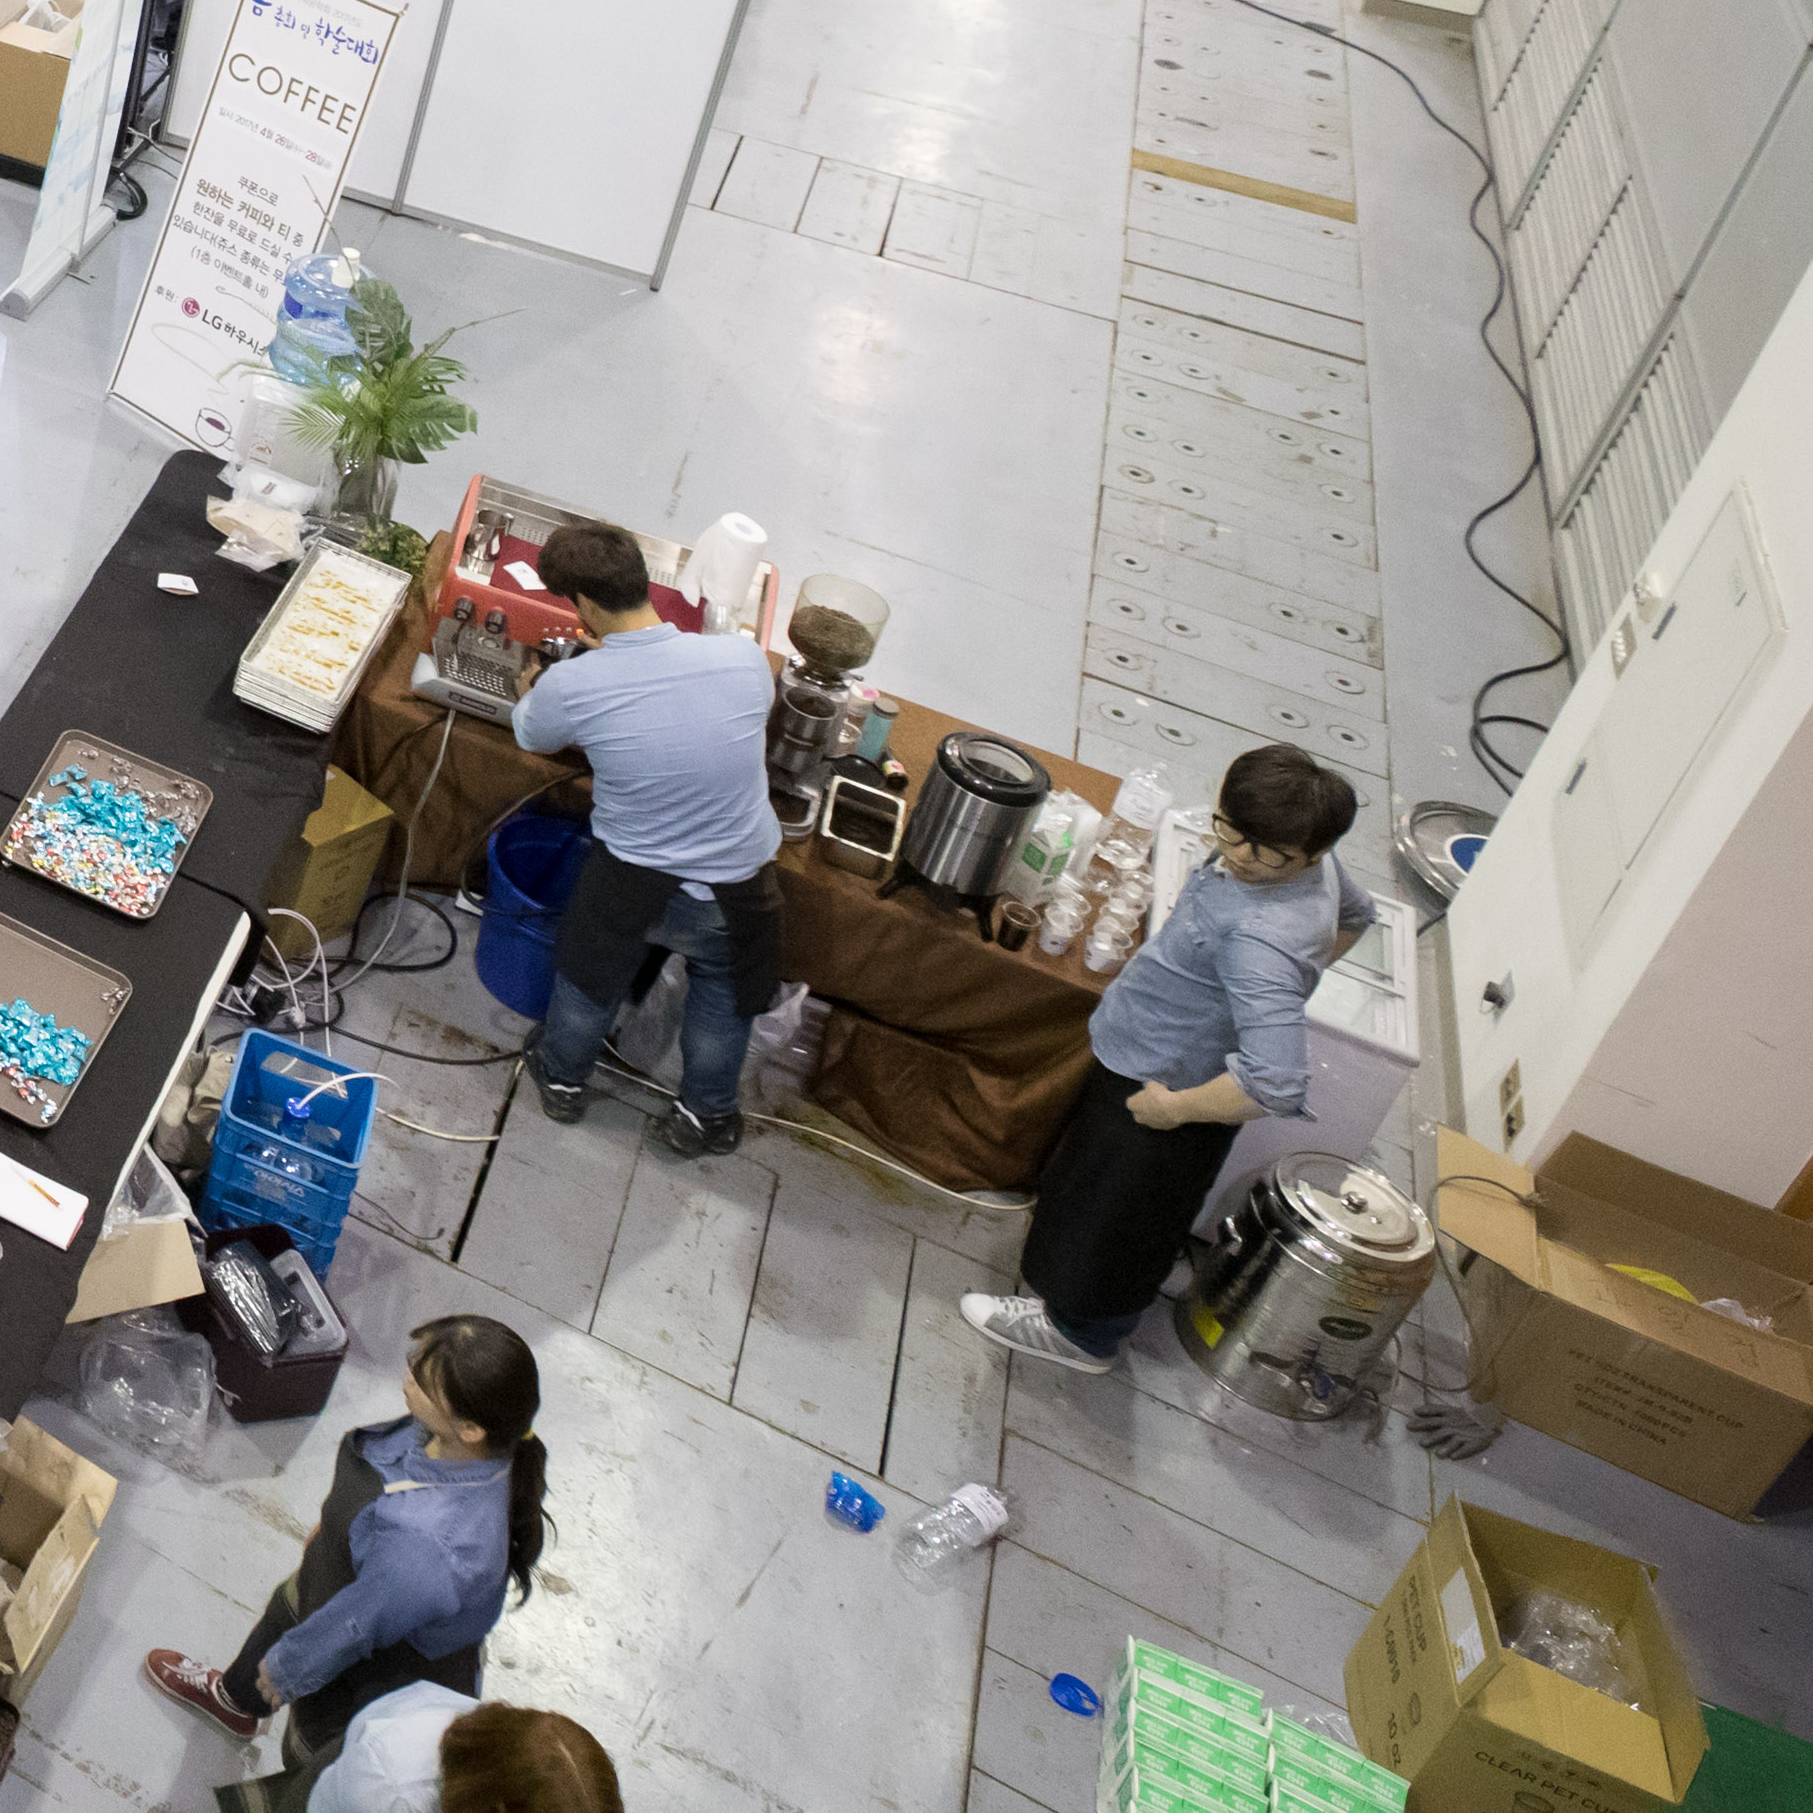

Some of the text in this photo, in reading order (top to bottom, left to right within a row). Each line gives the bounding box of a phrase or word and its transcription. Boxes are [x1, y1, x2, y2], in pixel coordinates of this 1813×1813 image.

[273, 5, 297, 30] 총회
[314, 16, 380, 65] 학술대회
[228, 52, 358, 136] COFFEE
[237, 175, 279, 208] 쿠폰으로
[192, 200, 227, 228] 한잔을
[226, 221, 260, 246] 무료로
[259, 239, 283, 260] 드실
[195, 178, 305, 248] 원하는 커피와 티 중
[213, 258, 254, 290] 이벤트홀
[239, 248, 271, 277] 종류는
[1627, 1422, 1668, 1446] CHINA
[1715, 1412, 1745, 1430] CUP
[1415, 1613, 1428, 1653] CUP
[1474, 1750, 1538, 1784] CLEAR
[1540, 1778, 1580, 1801] PET
